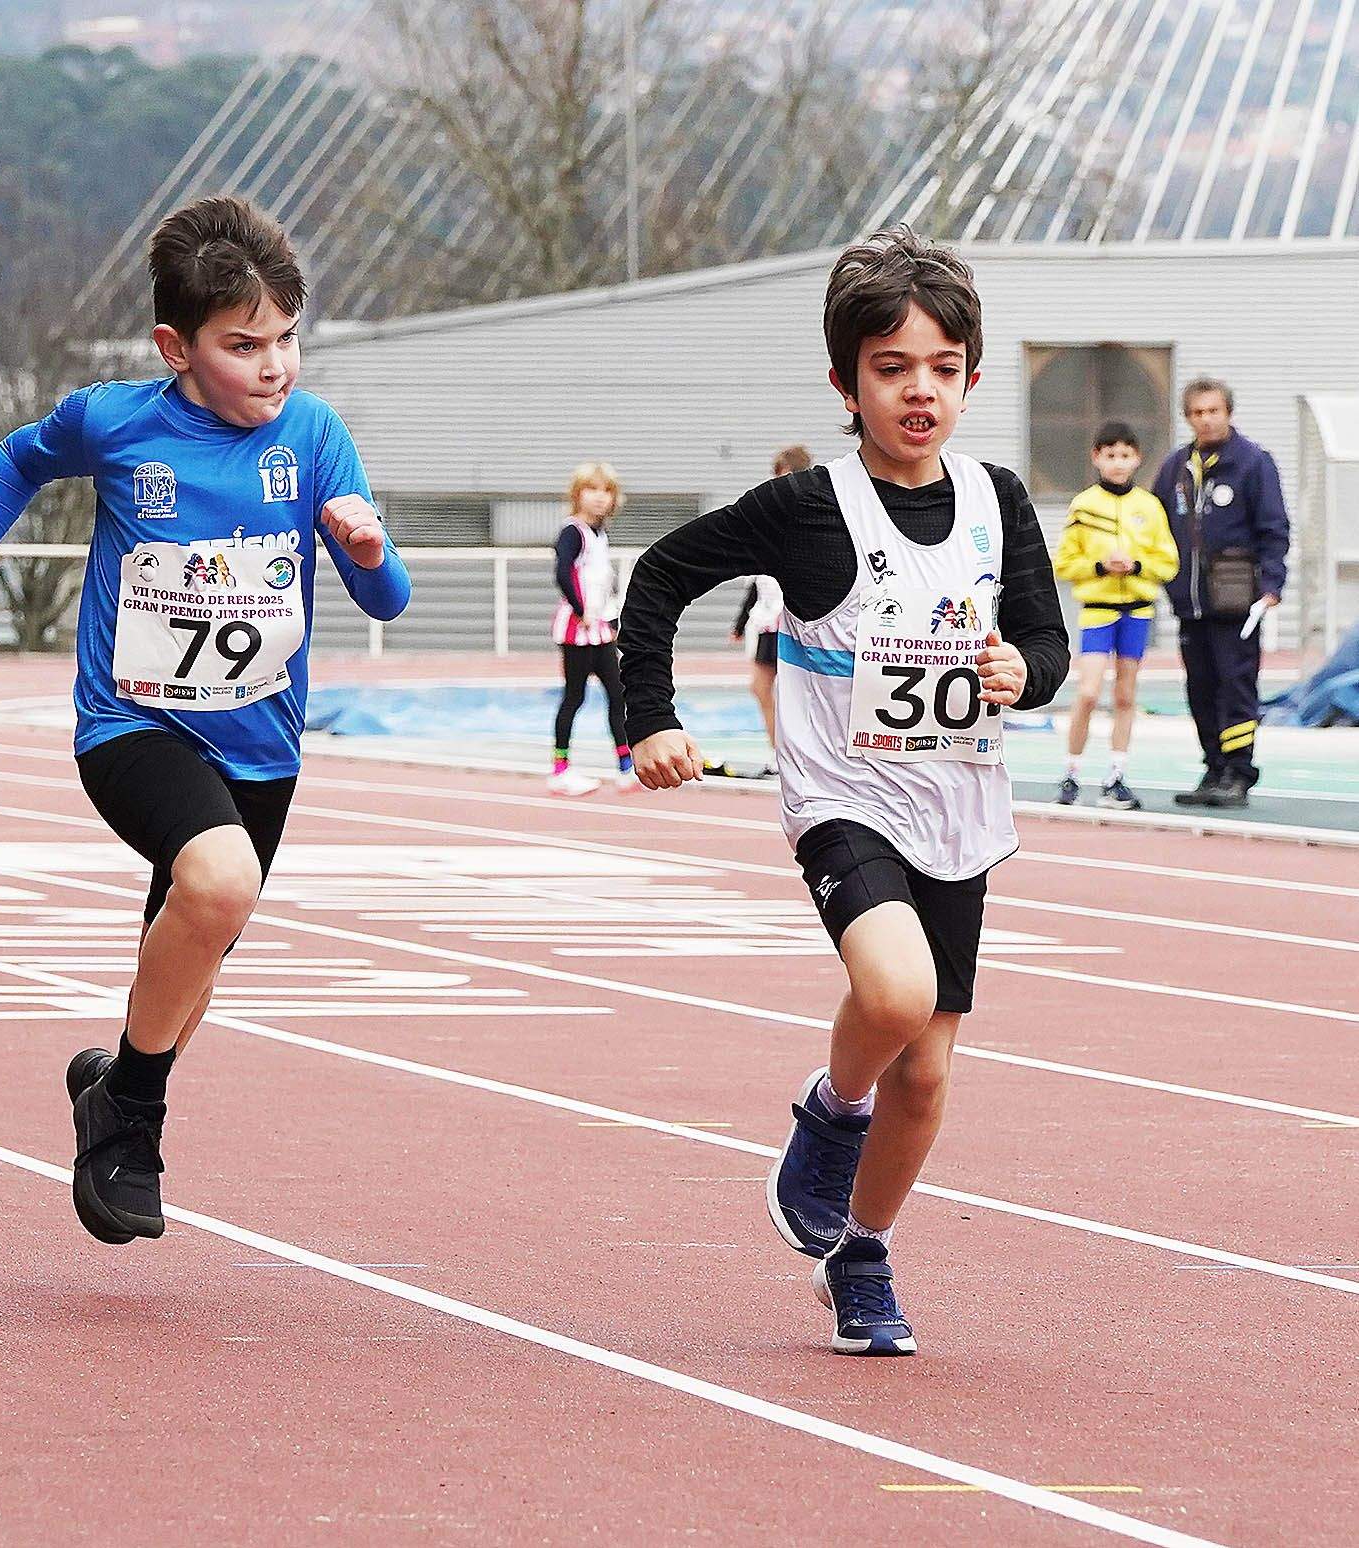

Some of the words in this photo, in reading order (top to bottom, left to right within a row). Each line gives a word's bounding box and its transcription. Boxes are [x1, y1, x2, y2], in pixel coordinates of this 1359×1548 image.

[131, 585, 149, 599] VII
[152, 588, 205, 605] TORNEO
[207, 595, 224, 605] DE
[227, 595, 255, 605] REIS
[257, 595, 284, 605] 2025
[123, 599, 159, 613] GRAN
[161, 603, 213, 619] PREMIO
[216, 609, 238, 619] JIM
[241, 608, 293, 619] SPORTS
[169, 617, 262, 681] 79
[870, 636, 890, 648] VII
[893, 638, 952, 650] TORNEO
[955, 640, 972, 651] DE
[861, 651, 902, 664] GRAN
[905, 653, 959, 666] PREMIO
[133, 680, 161, 695] SPORTS
[875, 665, 1001, 730] 30
[853, 731, 870, 745] JIM
[872, 733, 903, 749] SPORTS
